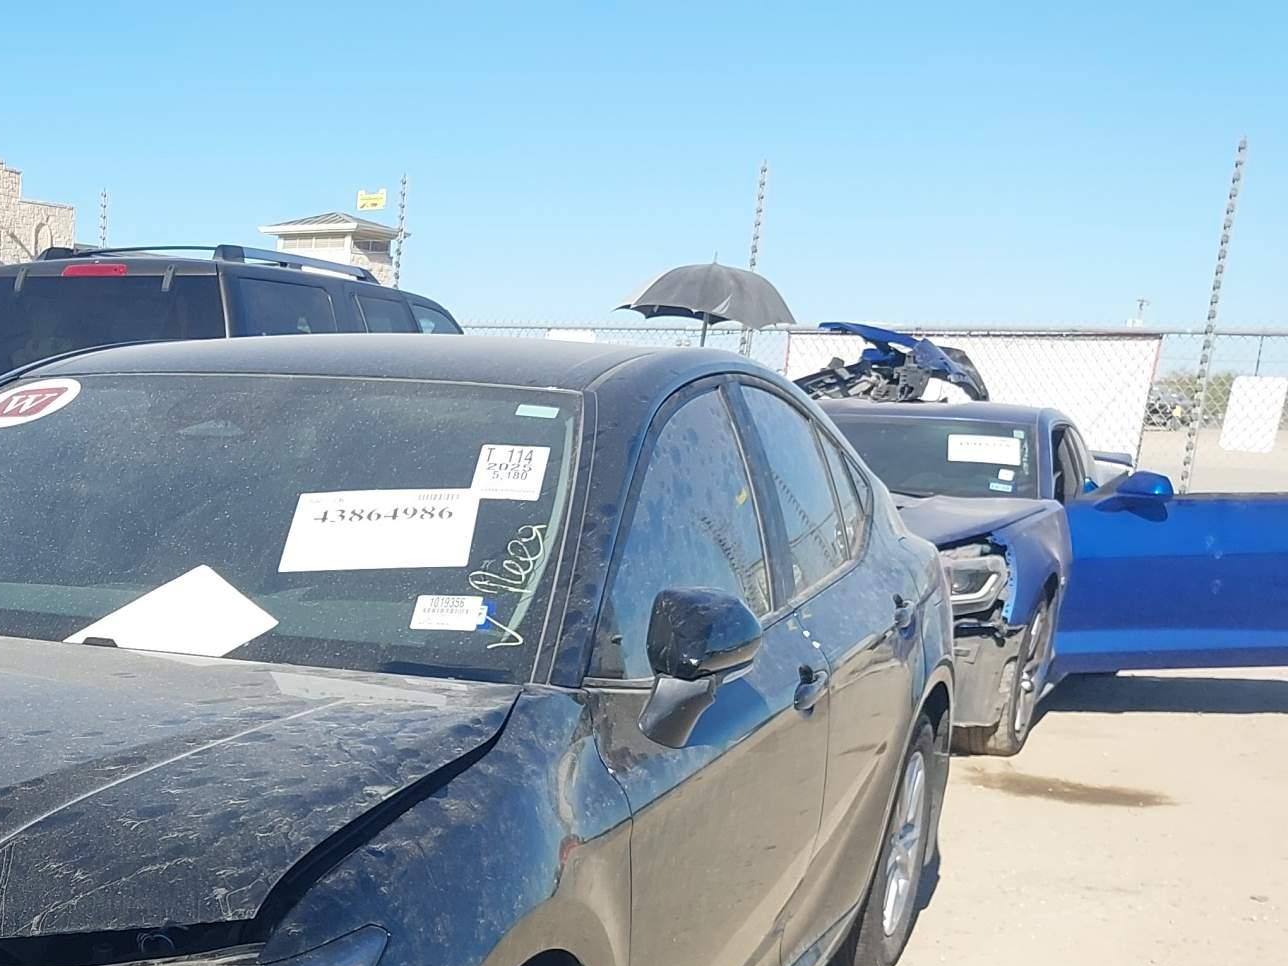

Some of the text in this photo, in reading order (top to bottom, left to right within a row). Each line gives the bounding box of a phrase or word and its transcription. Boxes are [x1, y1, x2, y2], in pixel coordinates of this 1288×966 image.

[3, 392, 58, 414] W
[485, 447, 534, 464] T 114
[313, 506, 454, 523] 43864986
